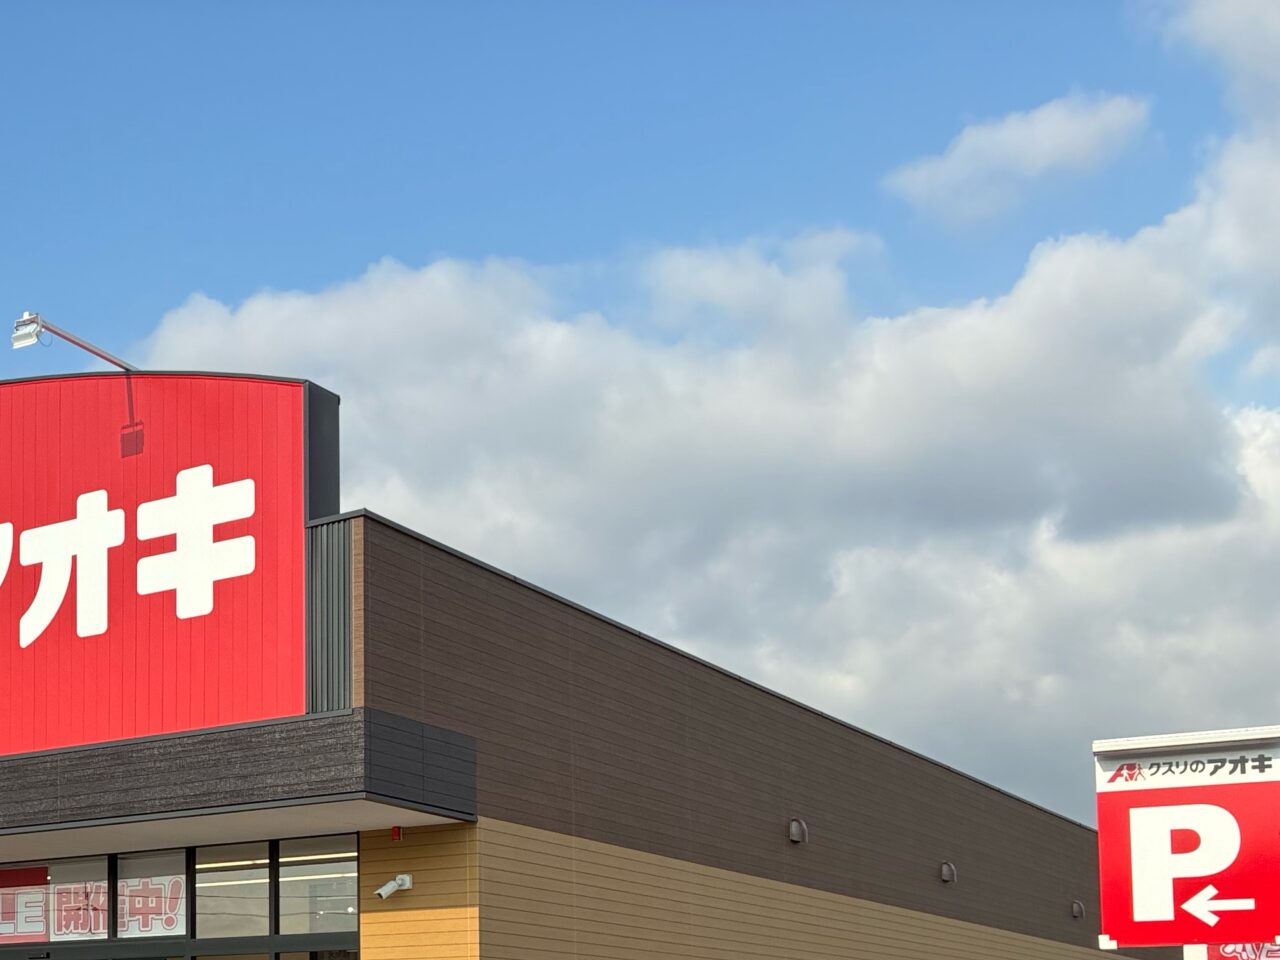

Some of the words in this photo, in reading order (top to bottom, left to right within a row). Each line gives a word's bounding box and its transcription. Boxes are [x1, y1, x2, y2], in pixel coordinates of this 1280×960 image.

[1148, 754, 1273, 777] クスリのアオキ
[1129, 804, 1241, 922] P
